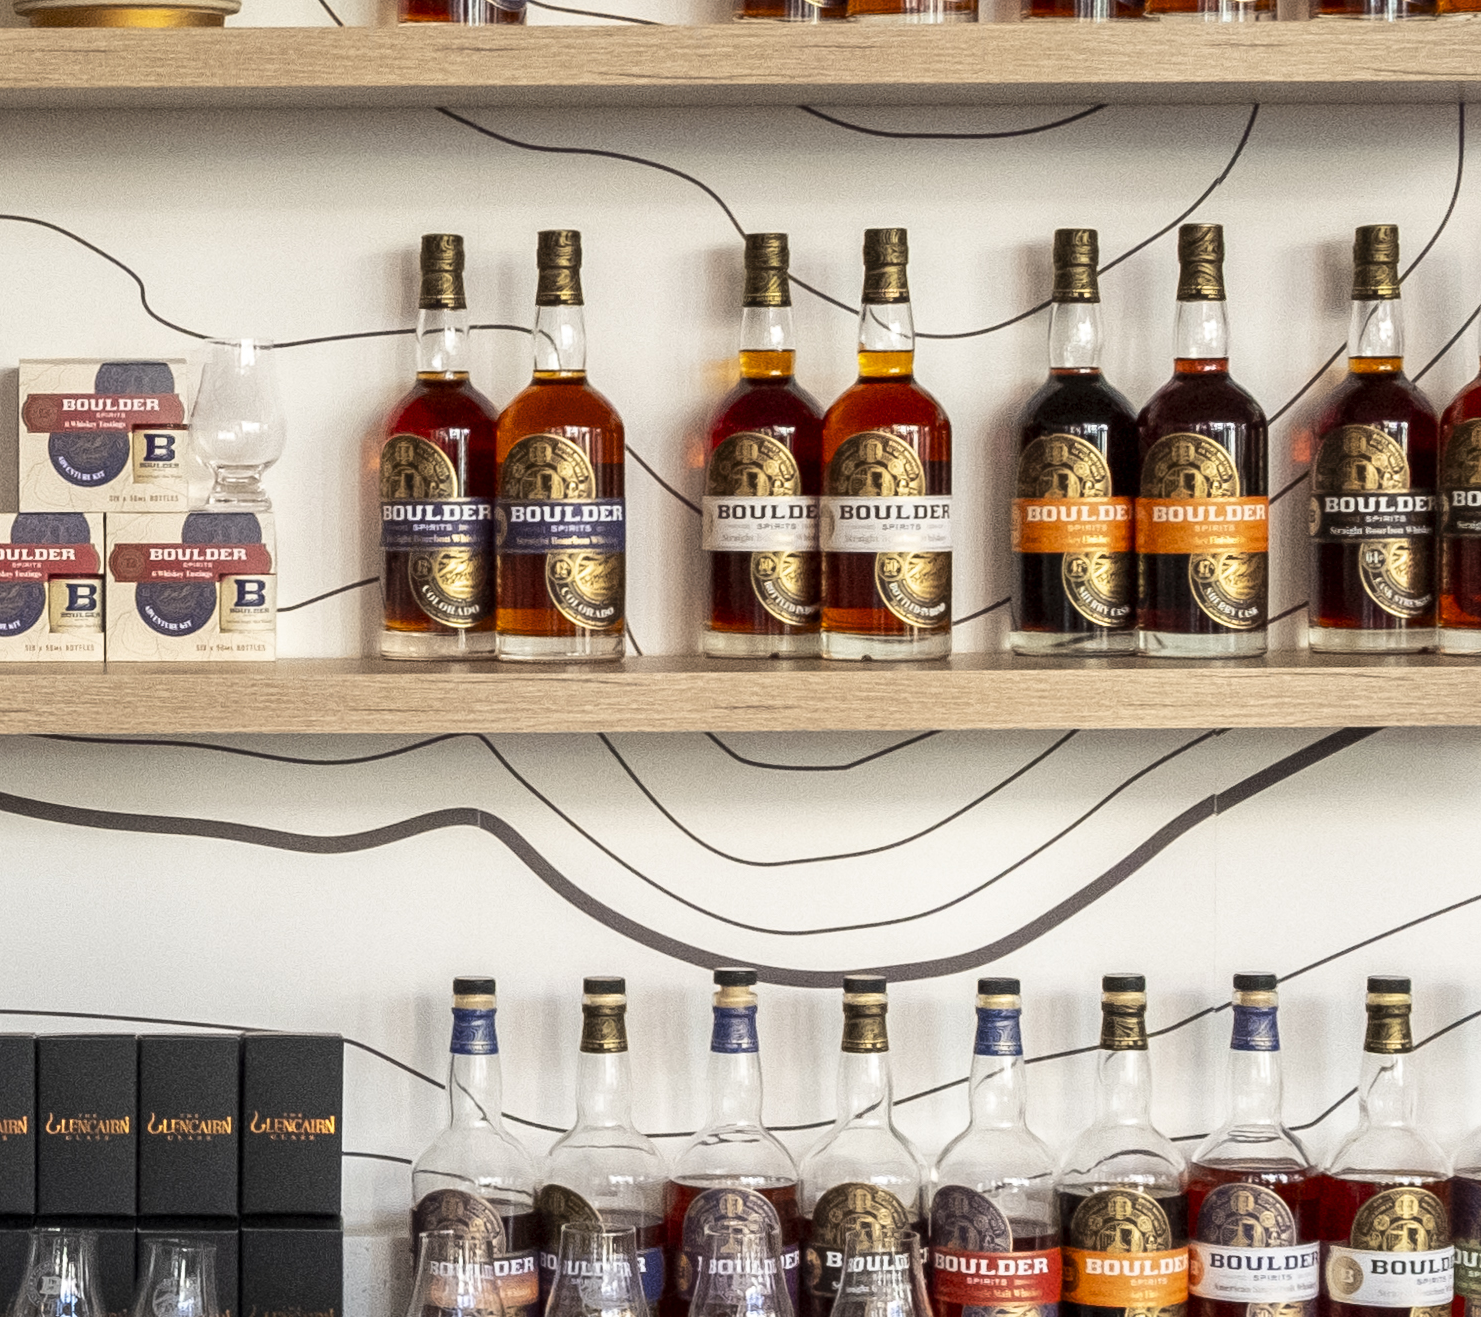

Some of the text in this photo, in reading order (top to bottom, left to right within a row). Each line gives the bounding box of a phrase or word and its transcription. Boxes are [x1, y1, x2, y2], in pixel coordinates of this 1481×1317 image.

[62, 398, 160, 417] BOULDER
[71, 420, 127, 431] Whiskey Tastings
[145, 433, 176, 462] B
[383, 504, 492, 522] BOULDER
[510, 505, 623, 523] BOULDER
[839, 503, 950, 521] BOULDER
[1152, 503, 1266, 522] BOULDER
[149, 548, 247, 568] BOULDER
[15, 570, 42, 581] Tastings
[65, 583, 97, 610] B
[234, 579, 266, 607] B
[422, 584, 480, 617] COLORADO
[561, 586, 615, 619] COLORADO
[45, 1112, 130, 1134] GLENCAIRN
[148, 1111, 232, 1134] GLENCAIRN
[250, 1111, 335, 1135] GLENCAIRN
[934, 1251, 1049, 1277] BOULDER
